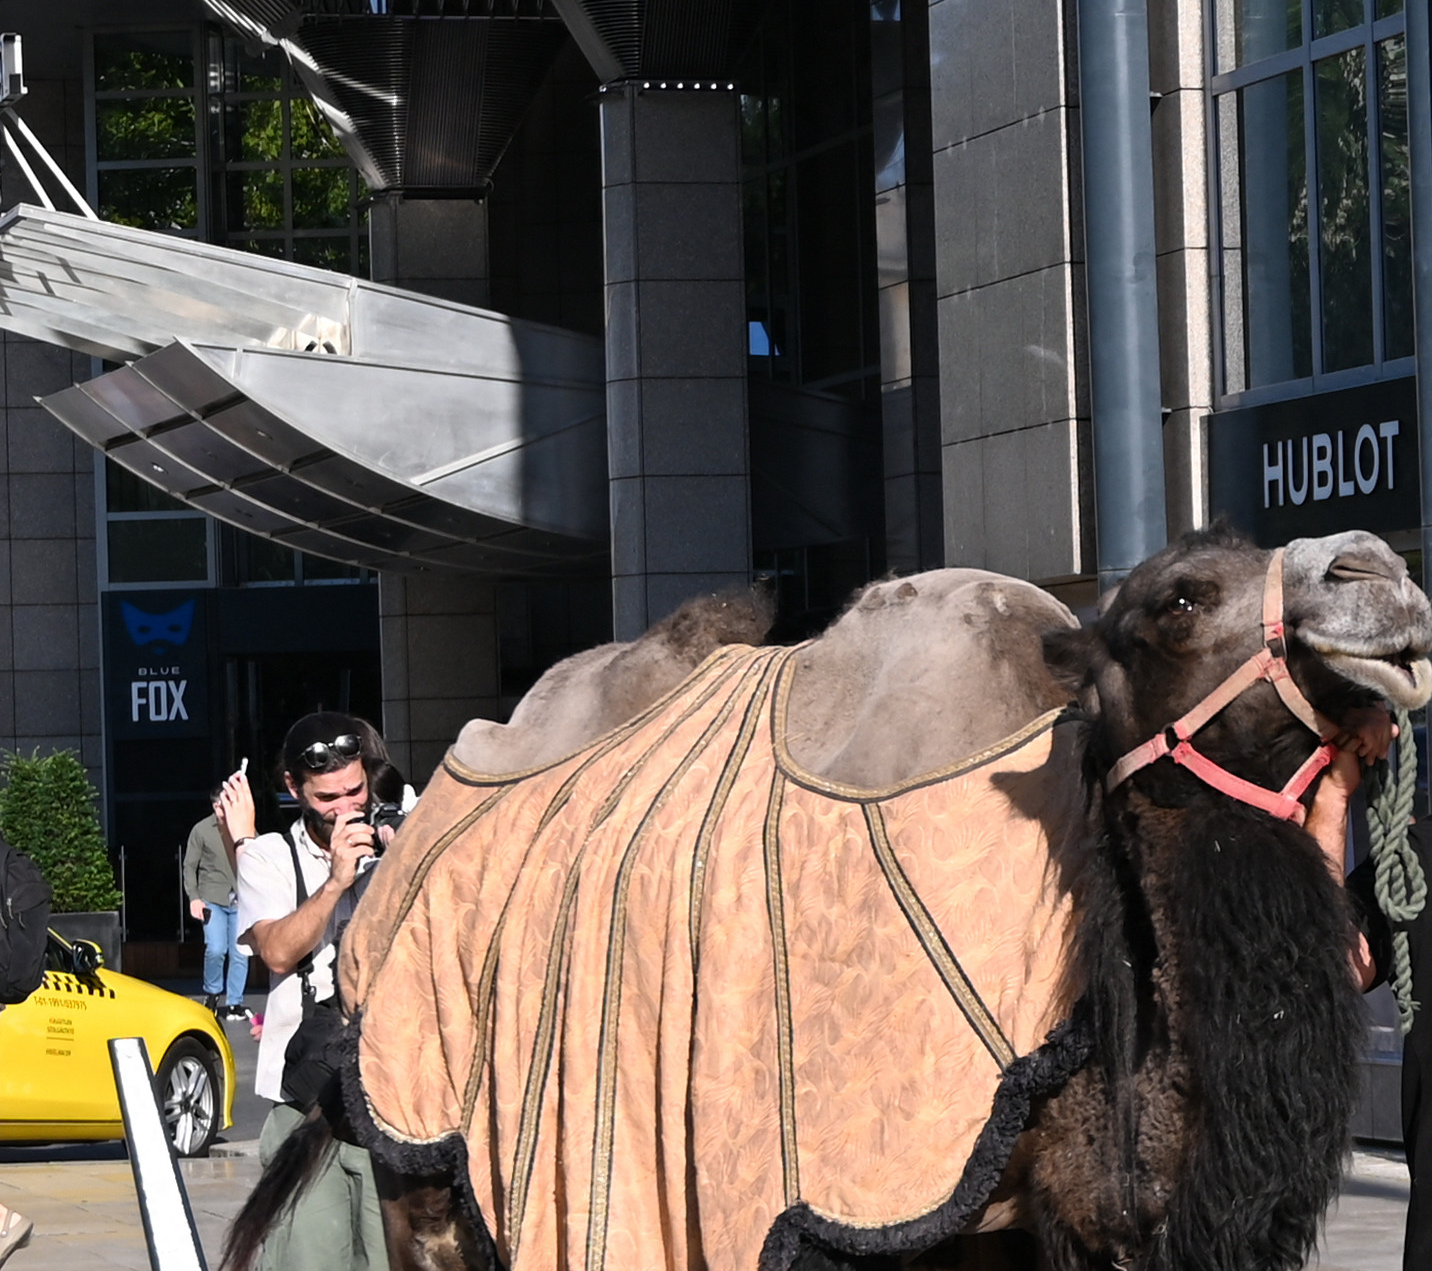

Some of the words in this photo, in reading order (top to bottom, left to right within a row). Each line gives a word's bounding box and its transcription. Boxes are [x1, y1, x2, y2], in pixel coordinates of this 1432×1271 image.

[1262, 419, 1400, 509] HUBLOT
[138, 666, 180, 677] BLUE
[131, 679, 189, 723] FOX
